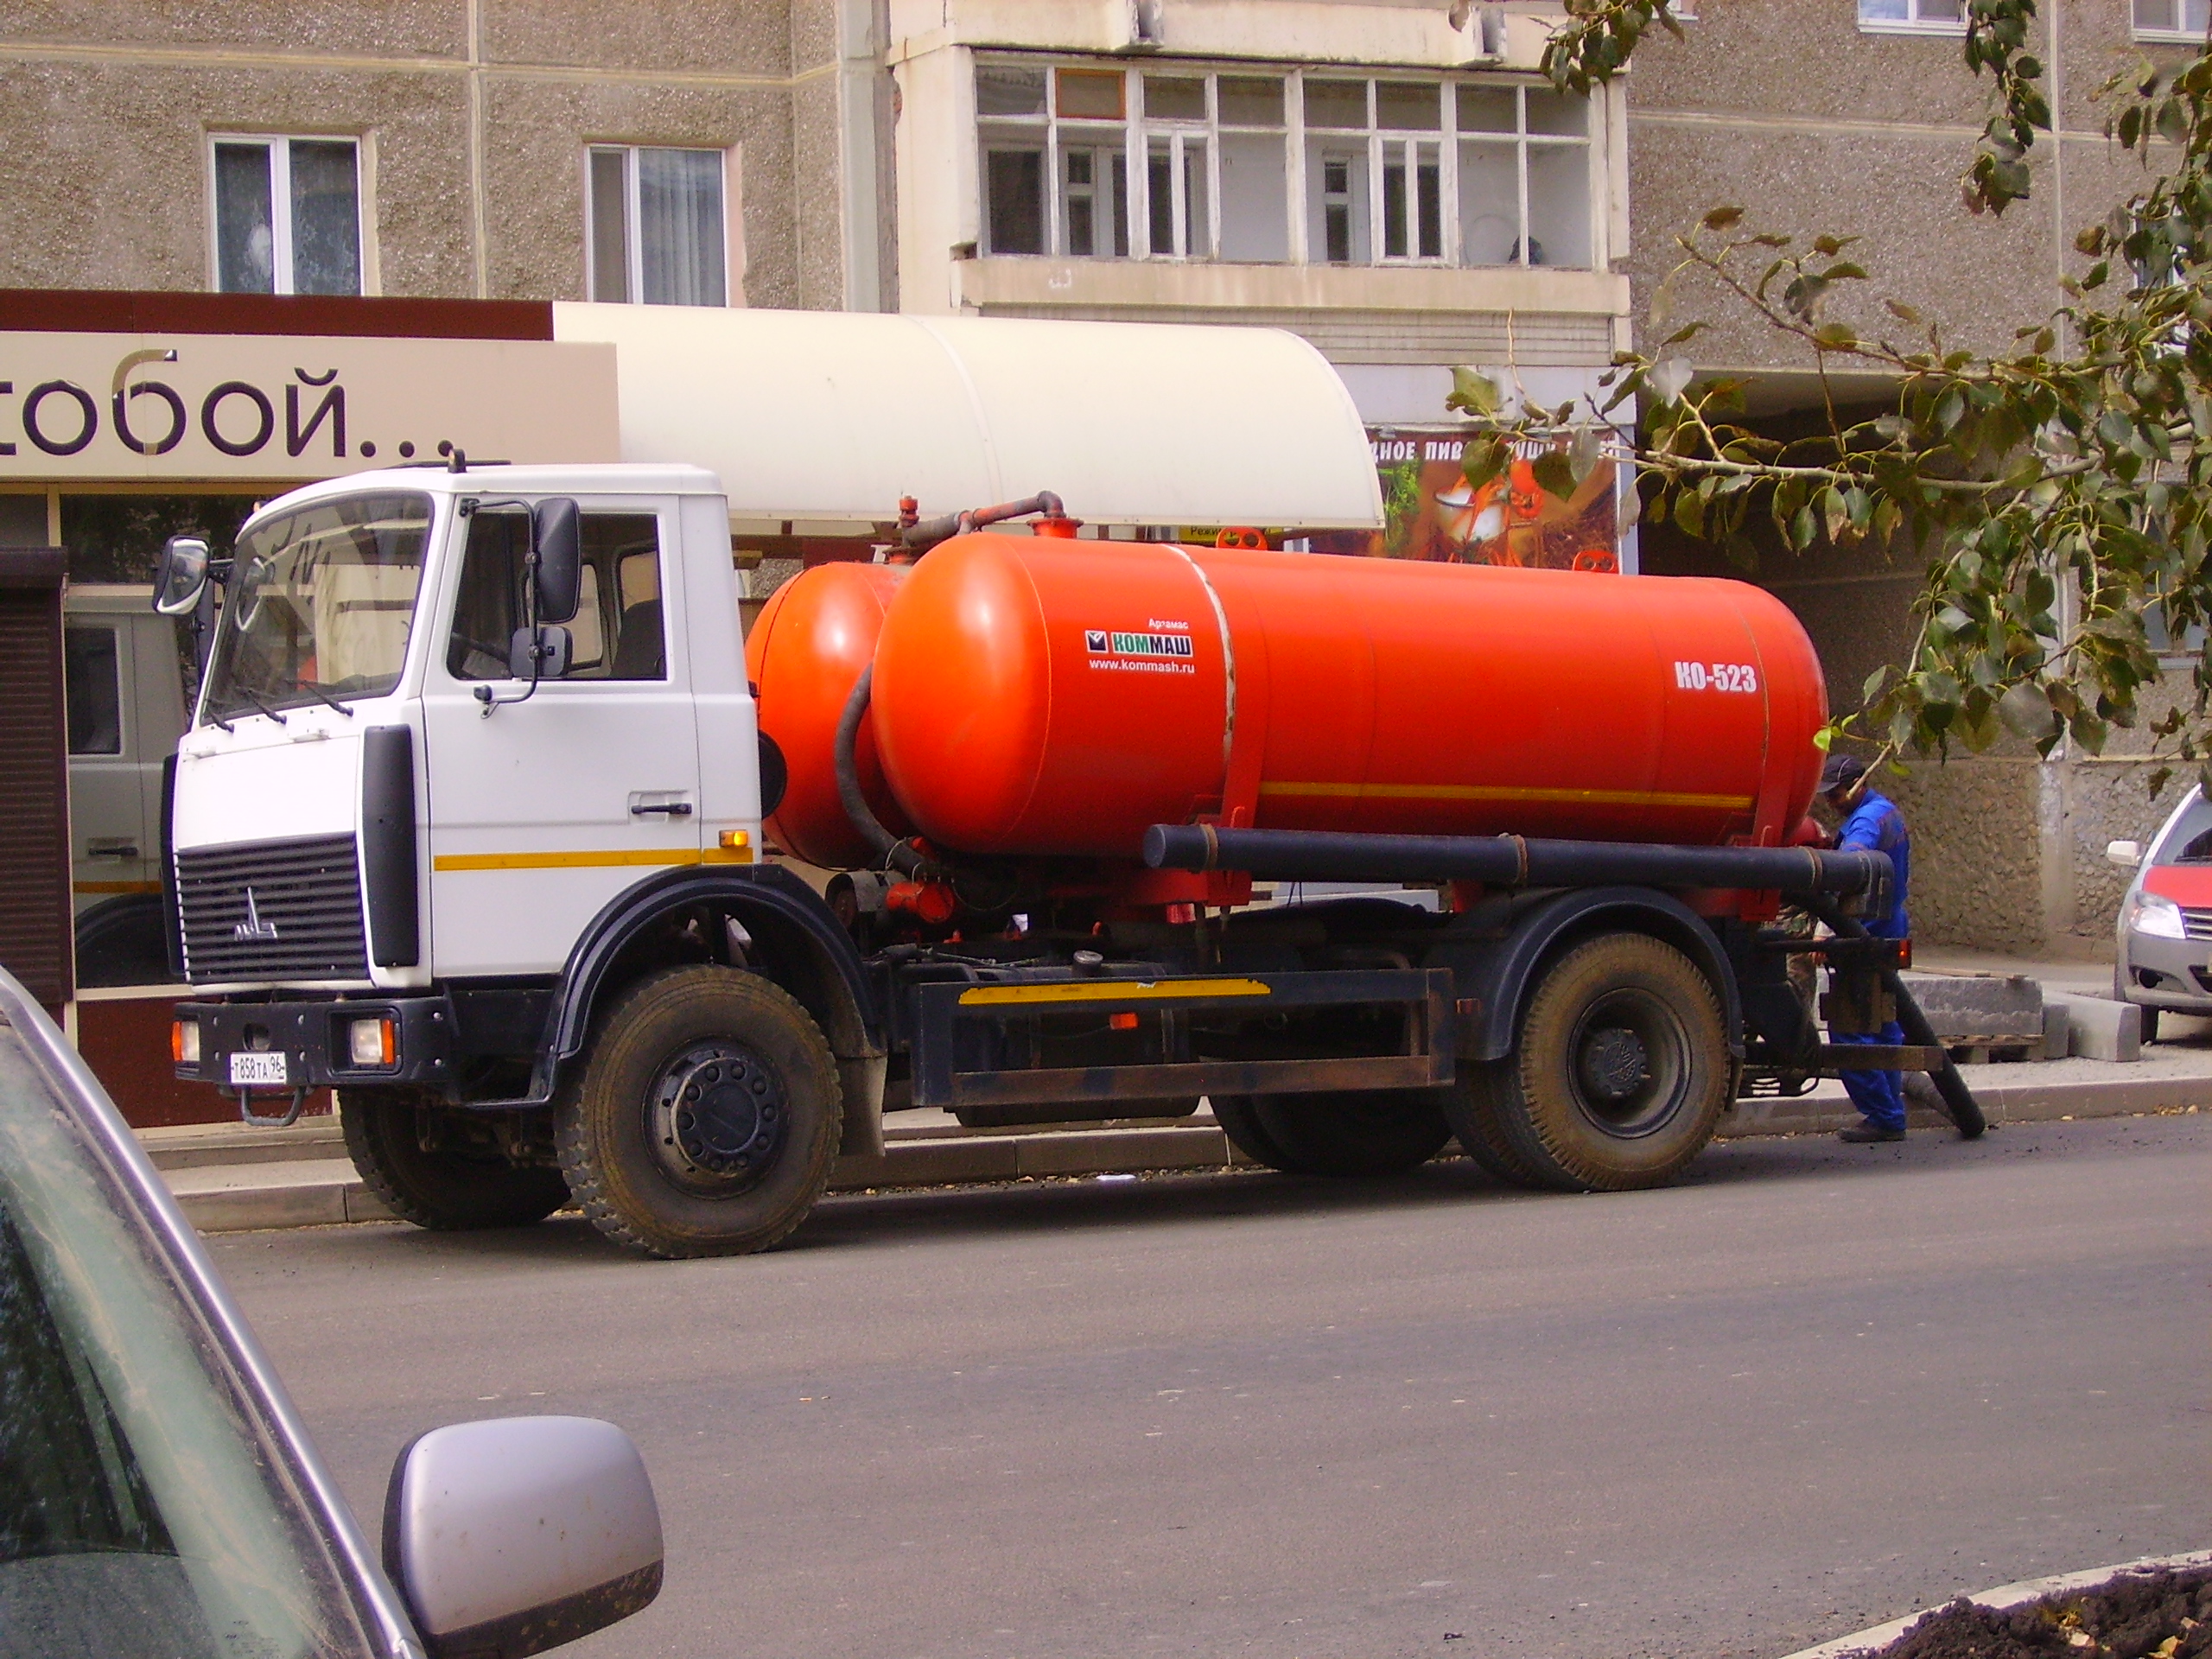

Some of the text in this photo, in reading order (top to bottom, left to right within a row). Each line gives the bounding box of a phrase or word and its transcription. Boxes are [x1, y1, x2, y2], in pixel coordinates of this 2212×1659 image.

[0, 348, 454, 459] обой...
[1425, 441, 1467, 461] ПИВ
[1112, 633, 1192, 656] КОММАШ
[1089, 658, 1195, 674] www.kommash.ru
[1674, 661, 1758, 693] КО-523
